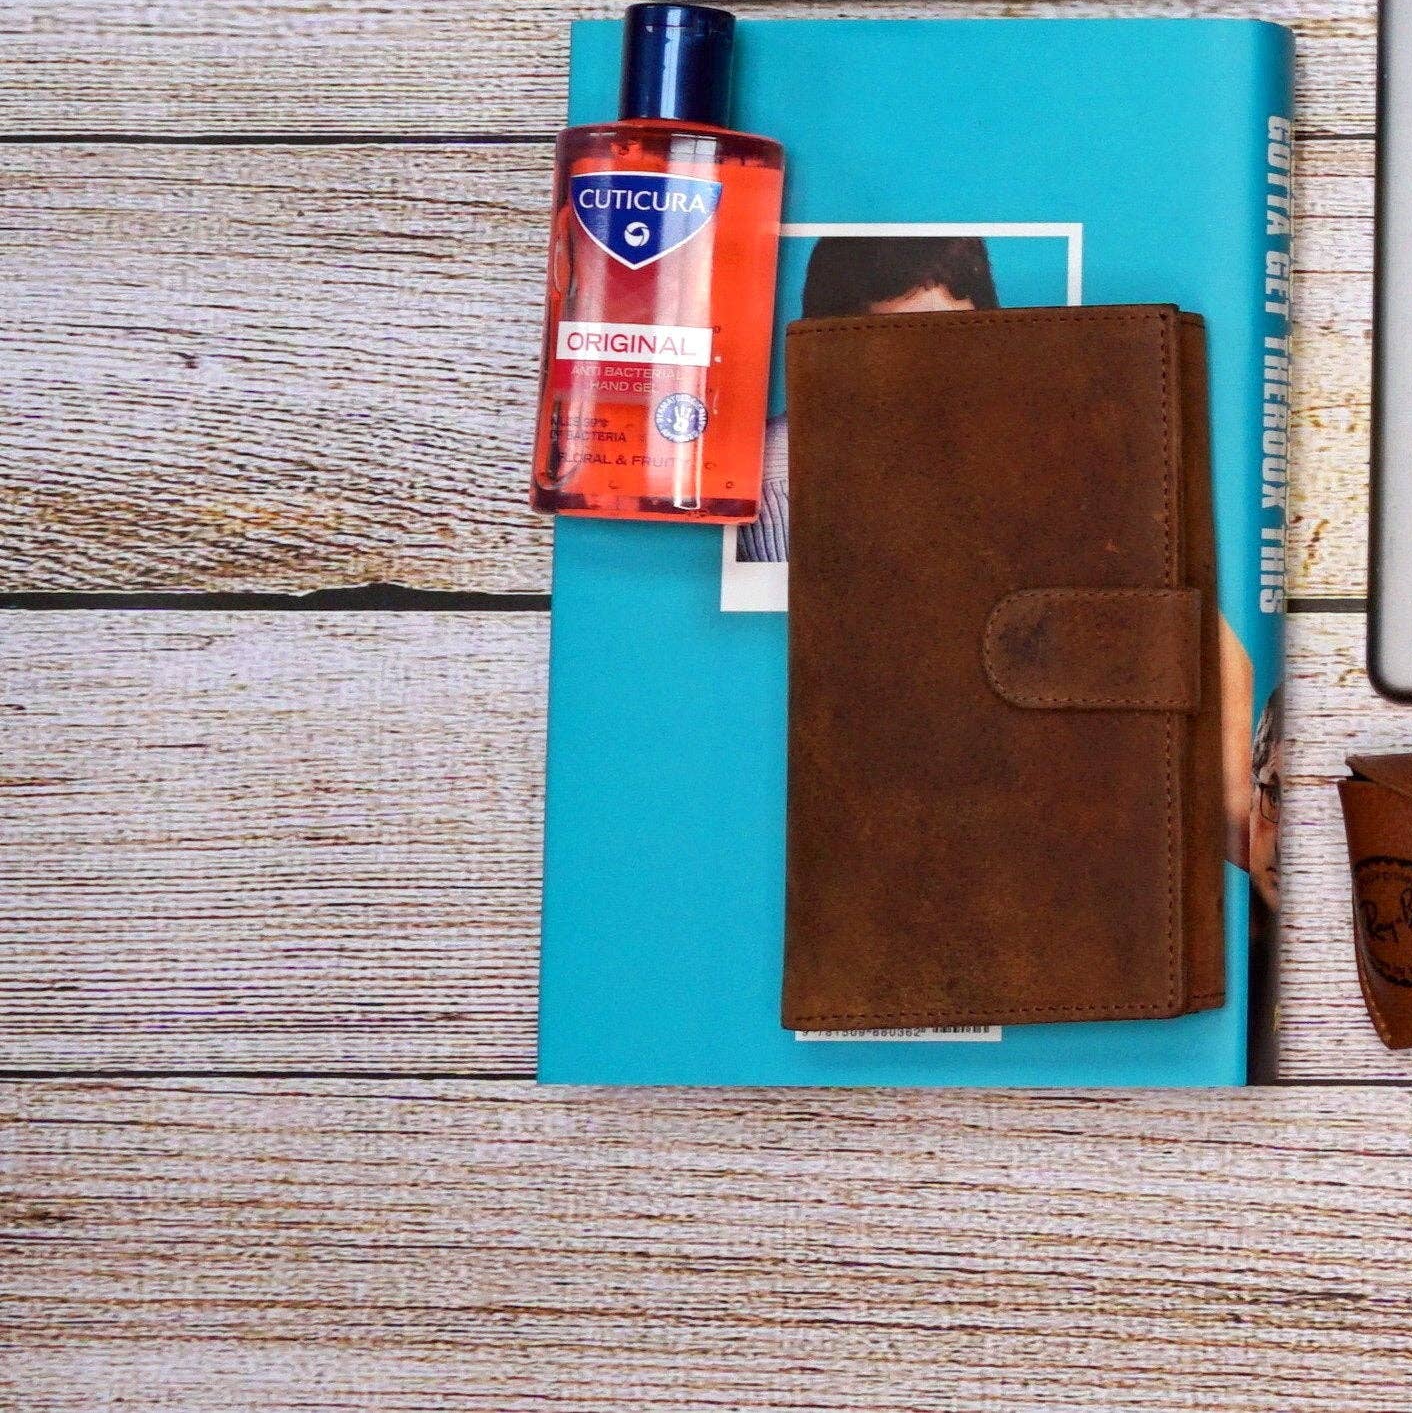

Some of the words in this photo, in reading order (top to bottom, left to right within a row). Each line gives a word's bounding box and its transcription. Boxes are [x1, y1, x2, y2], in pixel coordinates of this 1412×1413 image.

[578, 187, 708, 215] CUTICURA
[1266, 115, 1291, 236] GOTTA
[1264, 250, 1290, 322] GET
[567, 331, 697, 357] ORIGINAL
[1261, 336, 1289, 510] THEROUX
[615, 453, 627, 466] &
[1259, 527, 1286, 614] THIS
